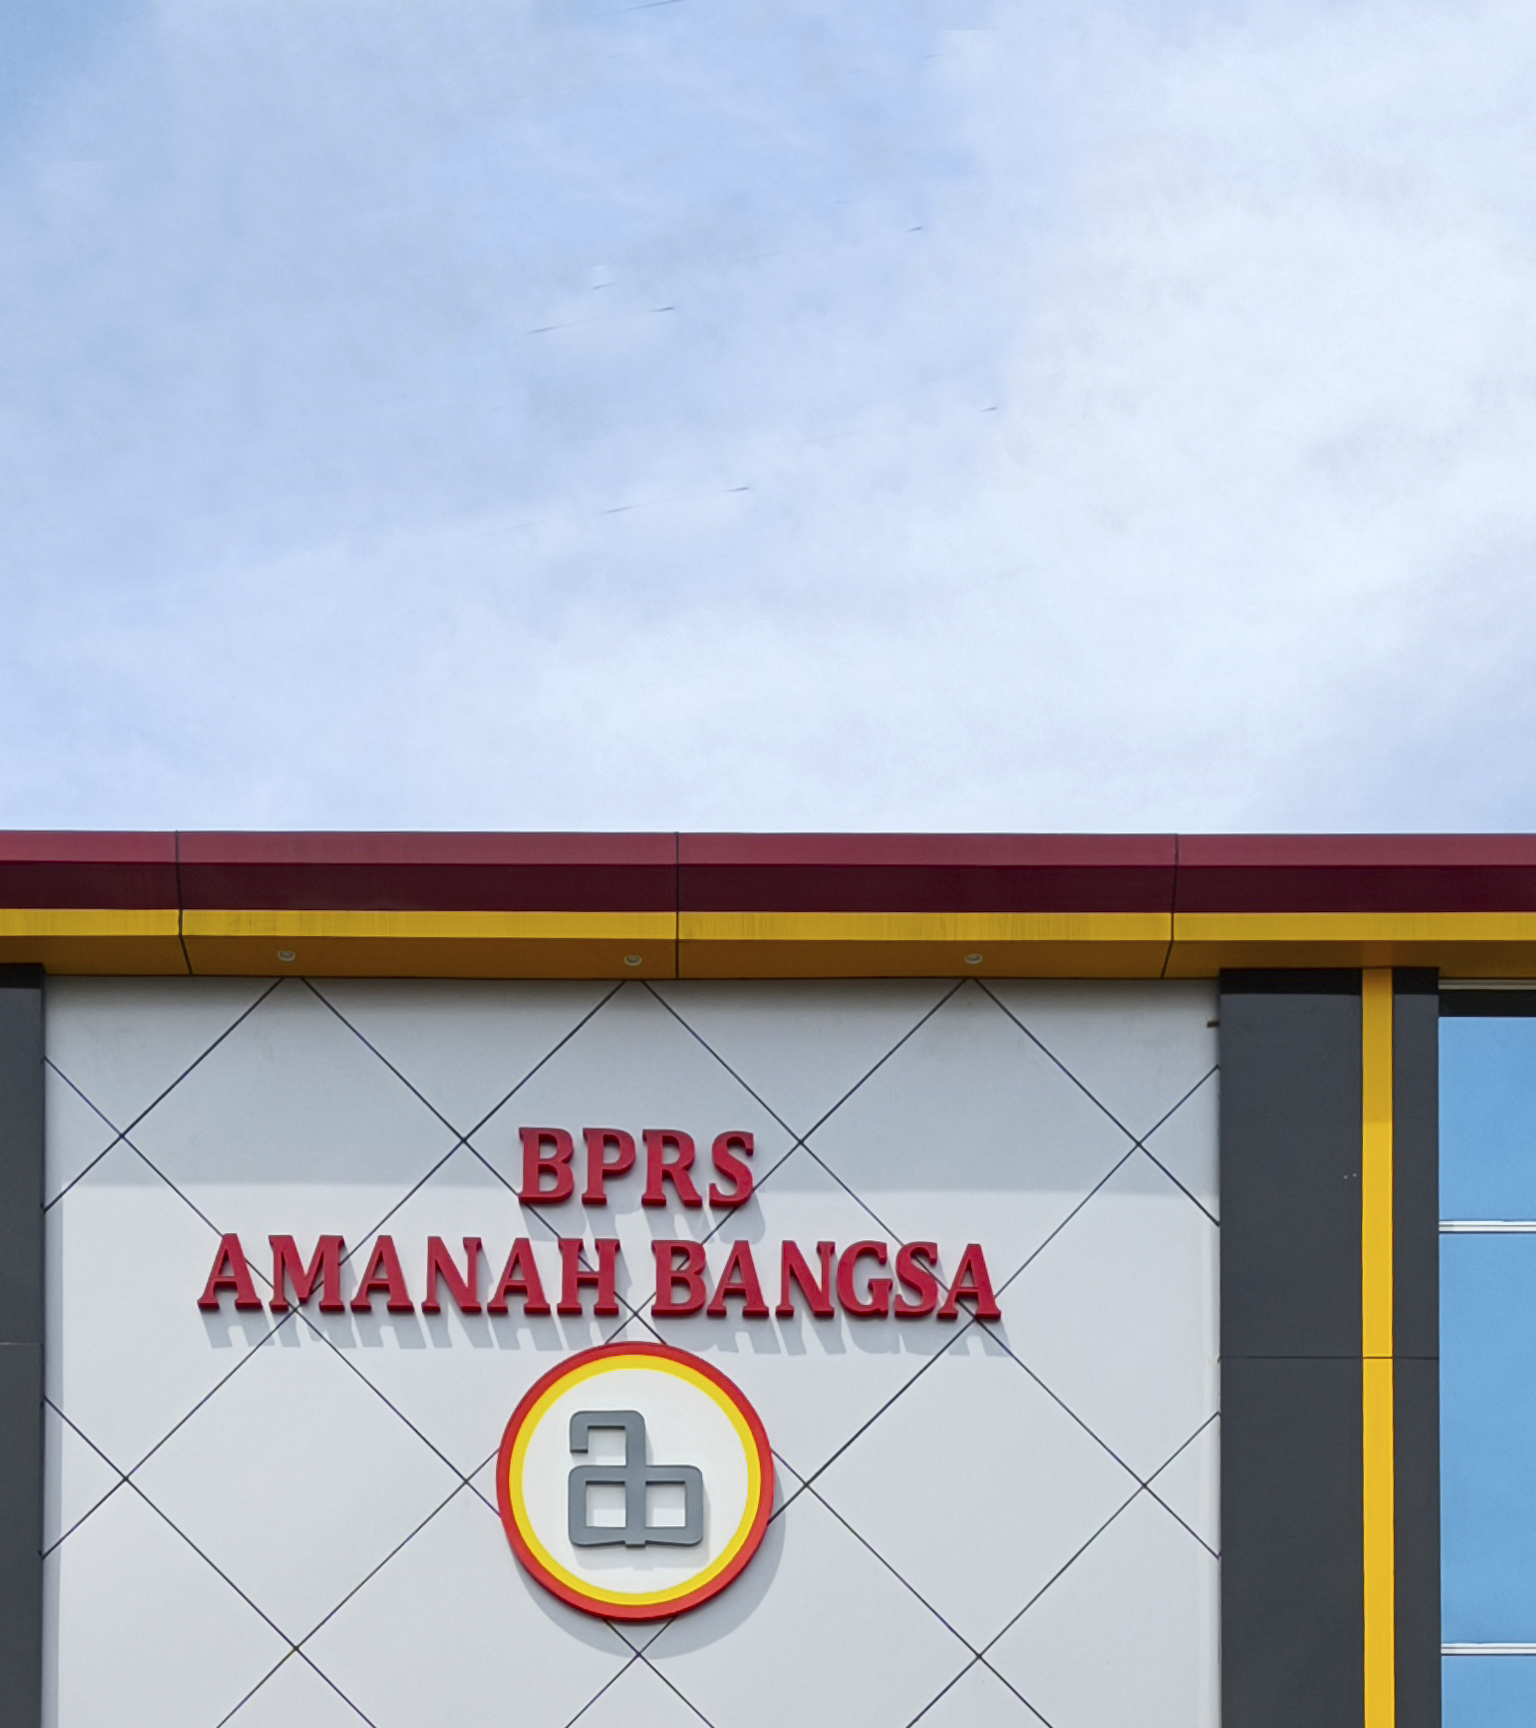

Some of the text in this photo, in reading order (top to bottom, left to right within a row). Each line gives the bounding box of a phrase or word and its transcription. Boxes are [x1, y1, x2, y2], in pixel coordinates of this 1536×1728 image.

[517, 1126, 755, 1209] BPRS
[198, 1232, 1003, 1321] AMANAH BANGSA
